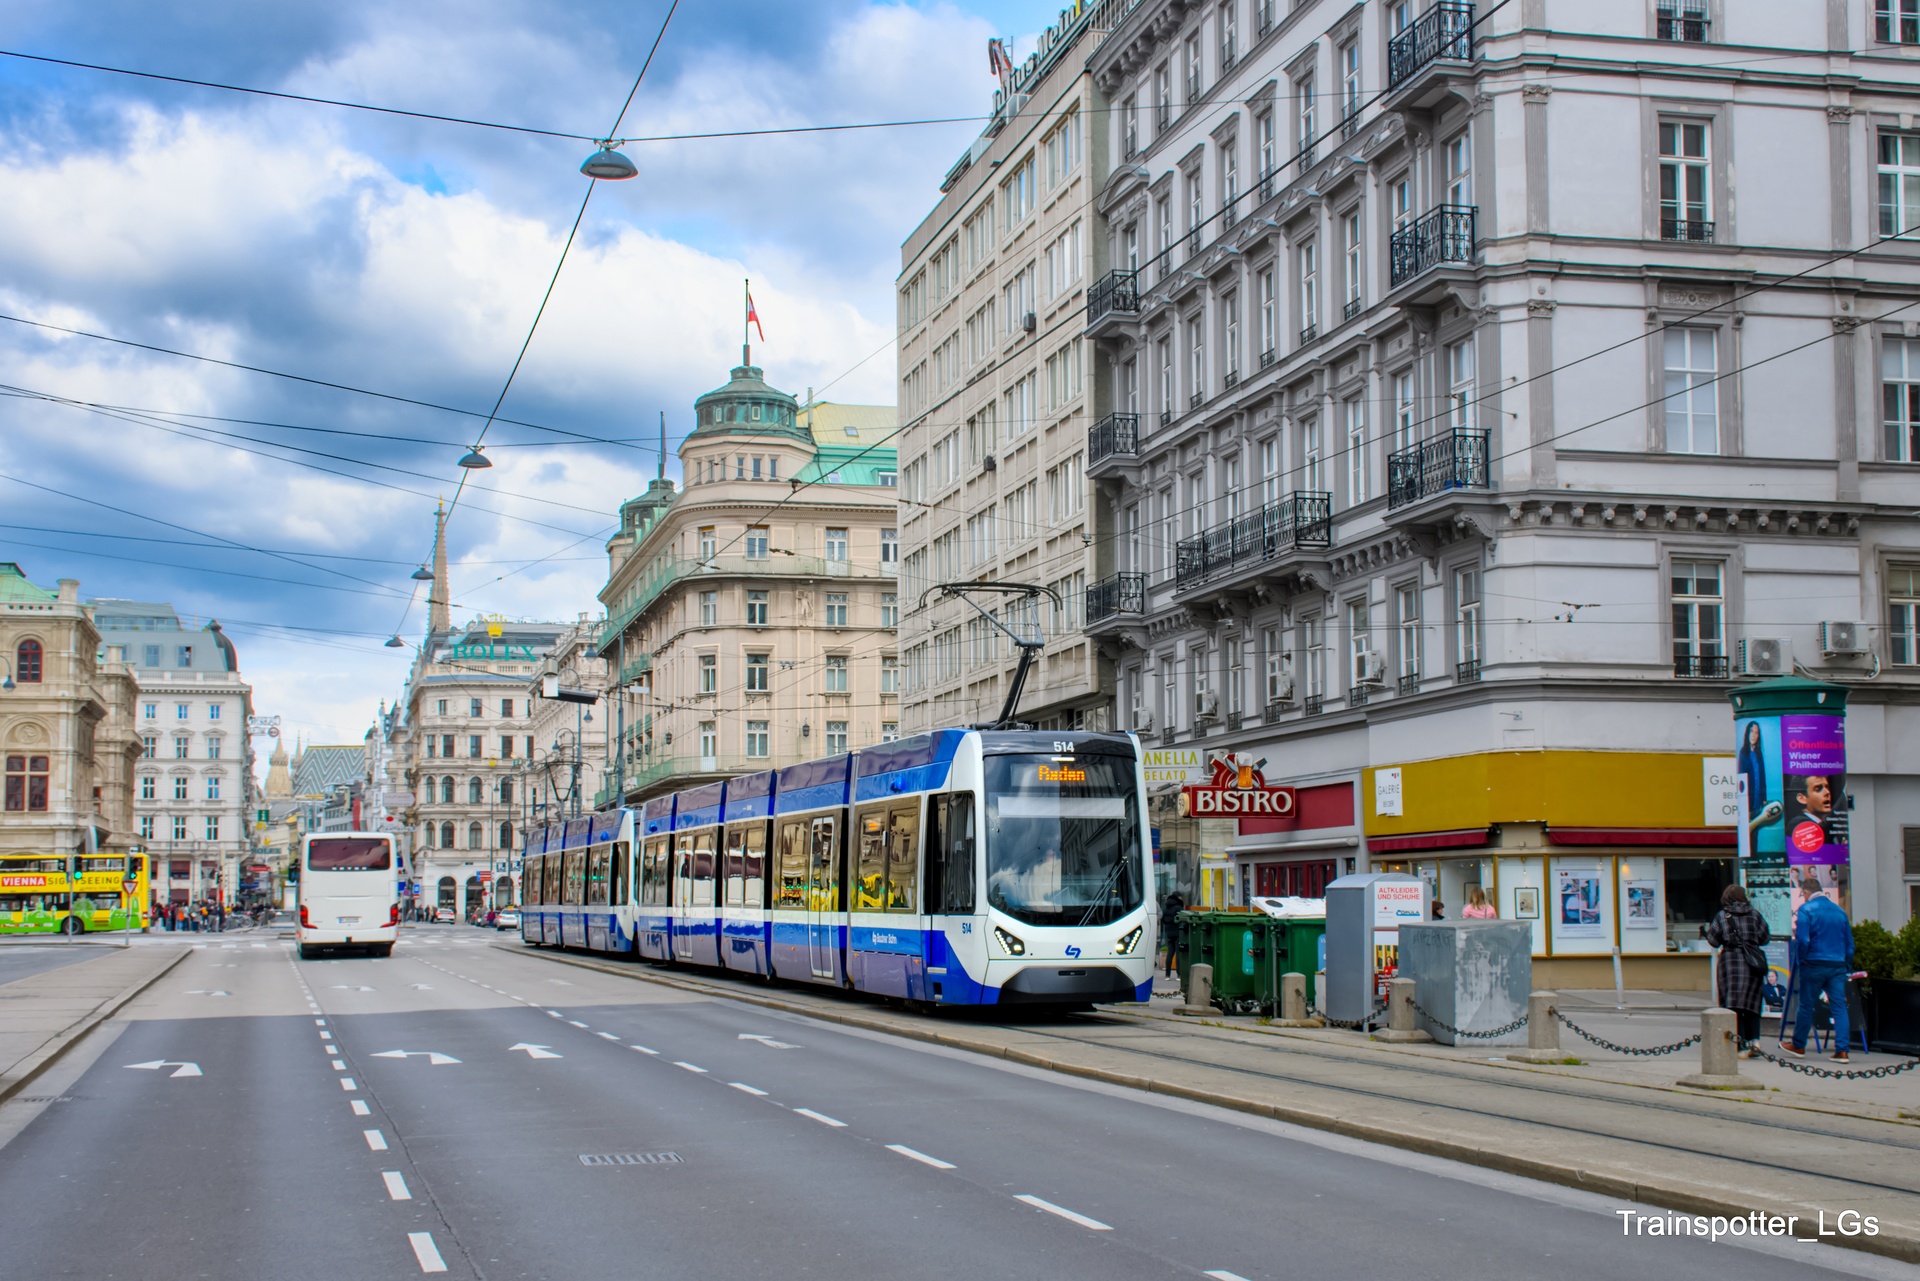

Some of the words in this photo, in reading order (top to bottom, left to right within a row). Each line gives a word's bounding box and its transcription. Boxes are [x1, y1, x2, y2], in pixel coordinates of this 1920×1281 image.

[452, 643, 537, 662] ROLEX
[1053, 741, 1075, 753] 514
[1143, 751, 1198, 766] ANELLA
[1788, 752, 1822, 760] Wiener
[1144, 769, 1187, 781] GELATO
[1709, 774, 1736, 786] GAL
[1196, 790, 1293, 813] BISTRO
[1722, 805, 1738, 815] OP
[2, 877, 45, 886] VIENNA
[48, 876, 120, 886] SIGSEEING
[961, 922, 972, 934] 514
